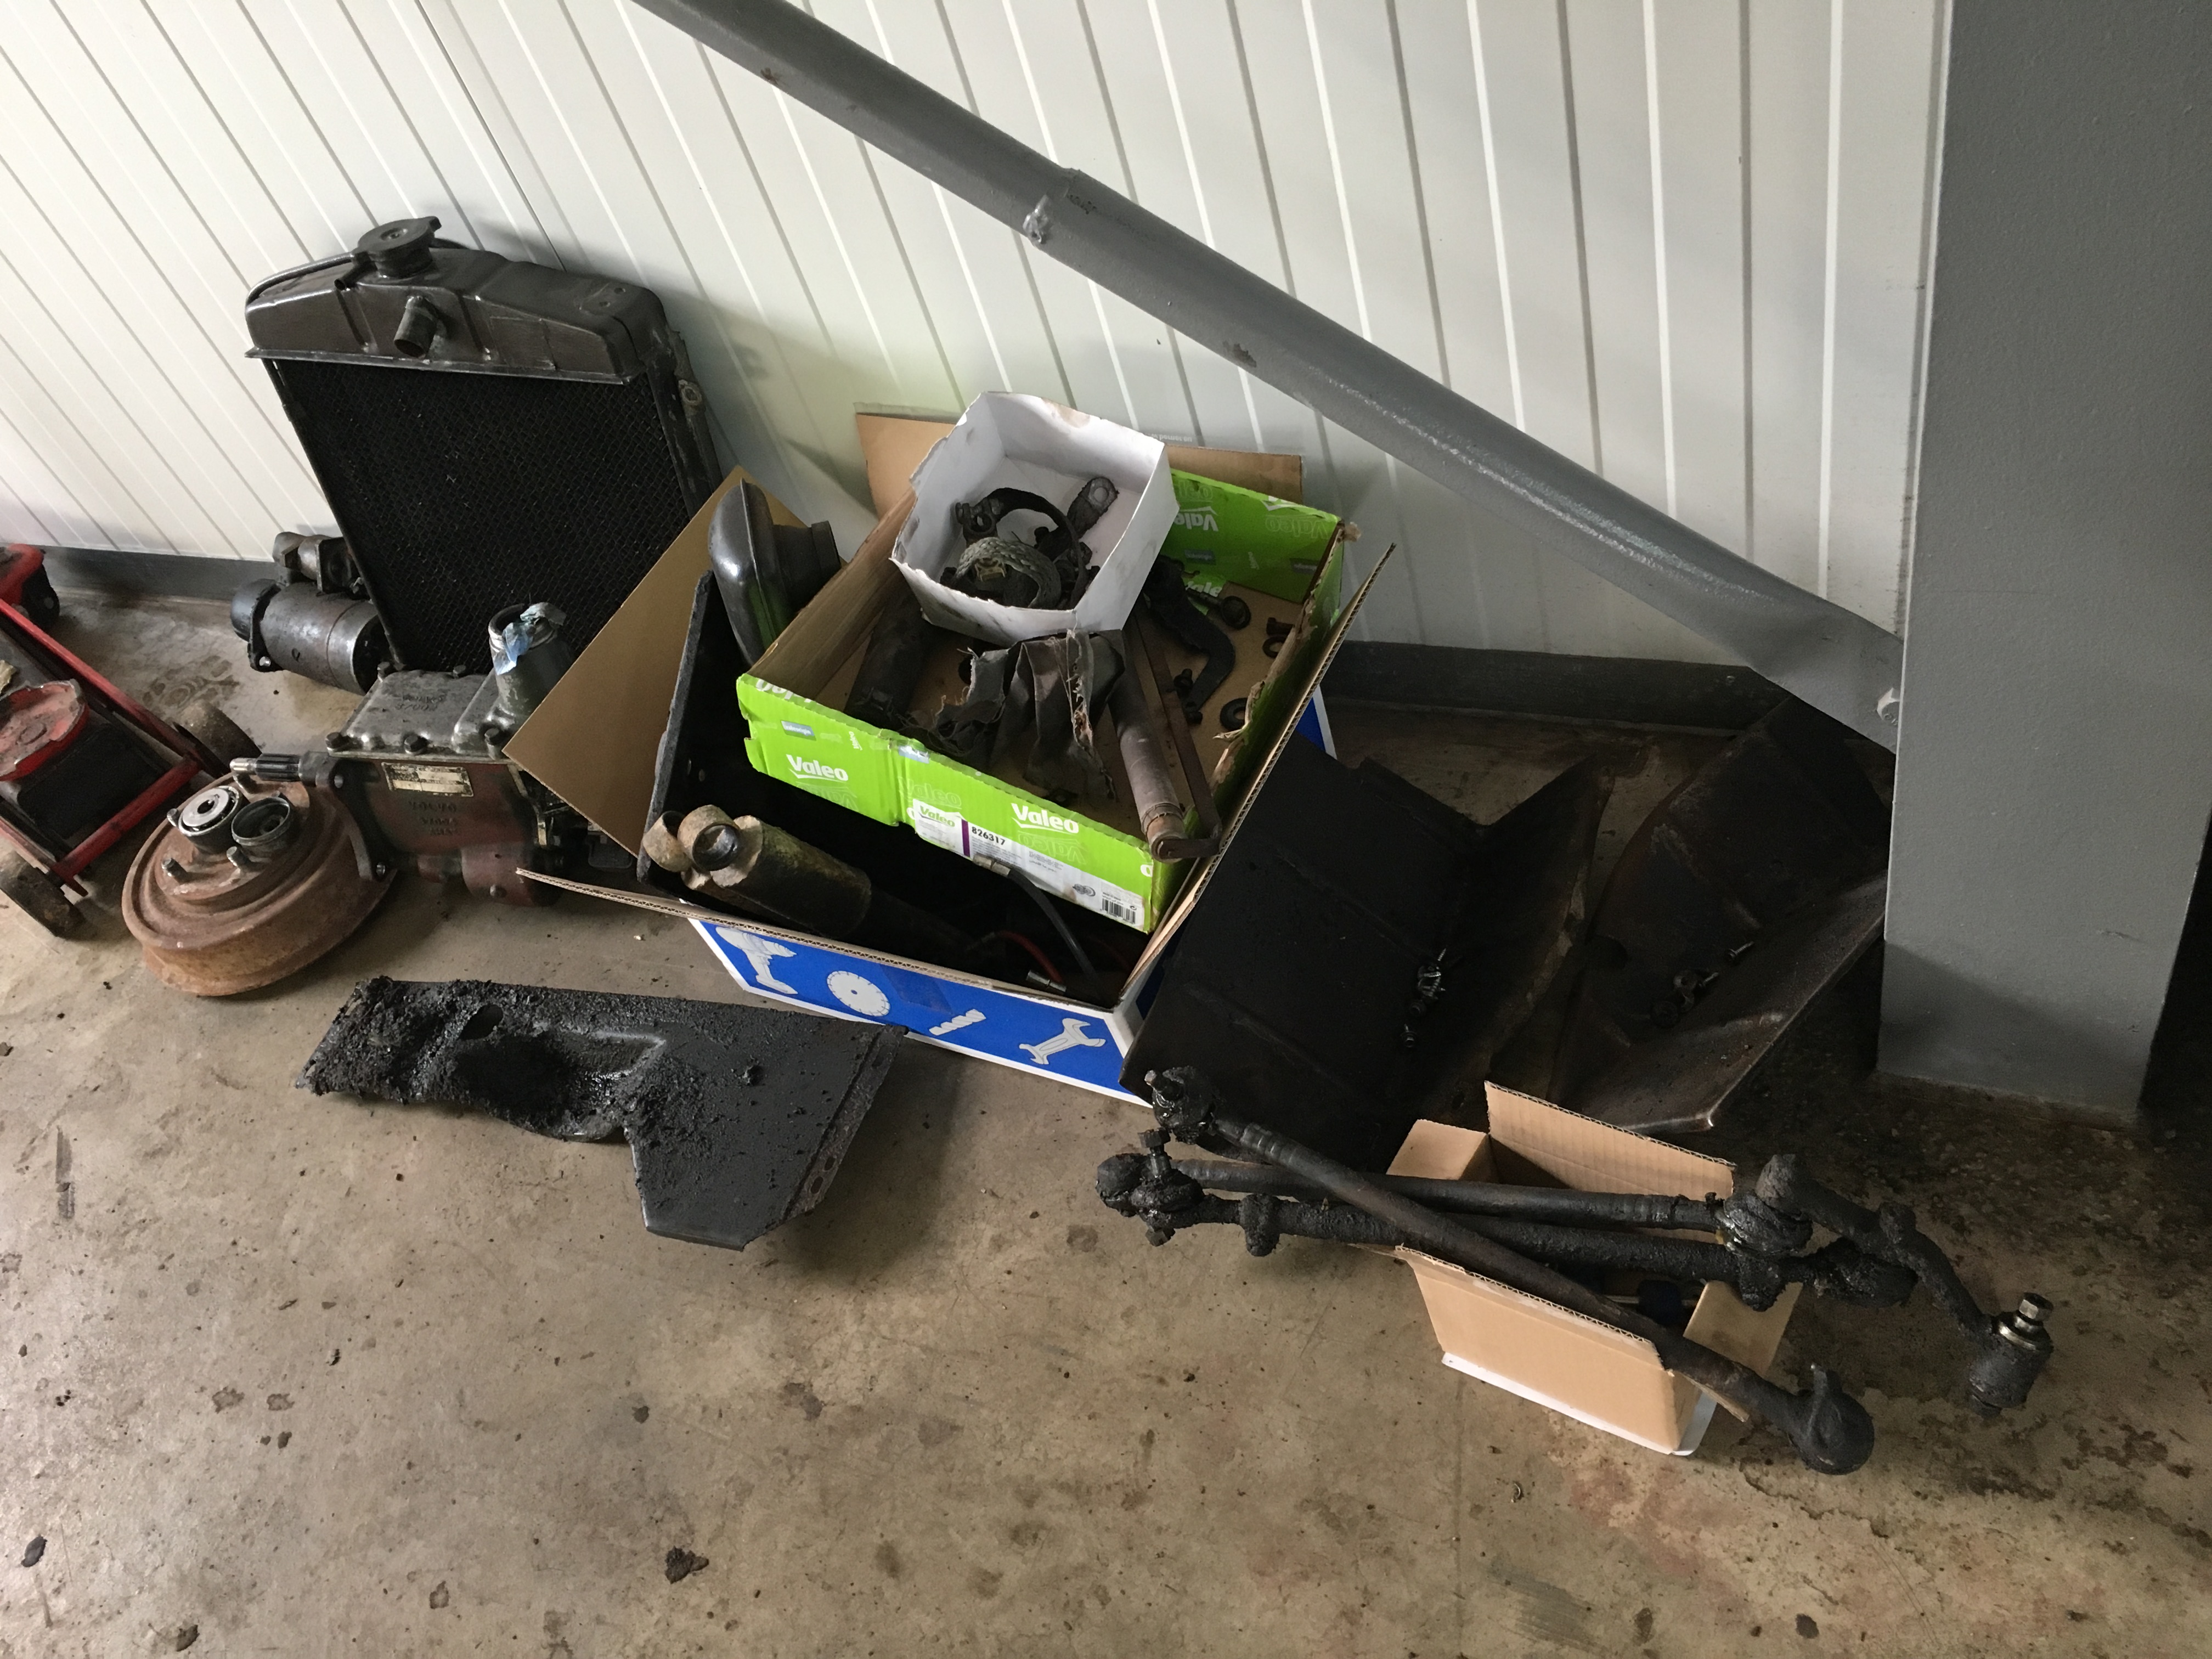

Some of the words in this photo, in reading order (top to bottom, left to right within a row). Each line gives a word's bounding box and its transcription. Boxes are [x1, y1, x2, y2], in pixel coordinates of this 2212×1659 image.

[1173, 512, 1219, 532] Vale
[1265, 517, 1328, 539] Valeo
[786, 754, 849, 781] Valeo
[920, 805, 955, 827] Valeo
[1012, 802, 1079, 834] Valeo
[972, 826, 1006, 846] 826317
[1018, 833, 1086, 865] Valeo
